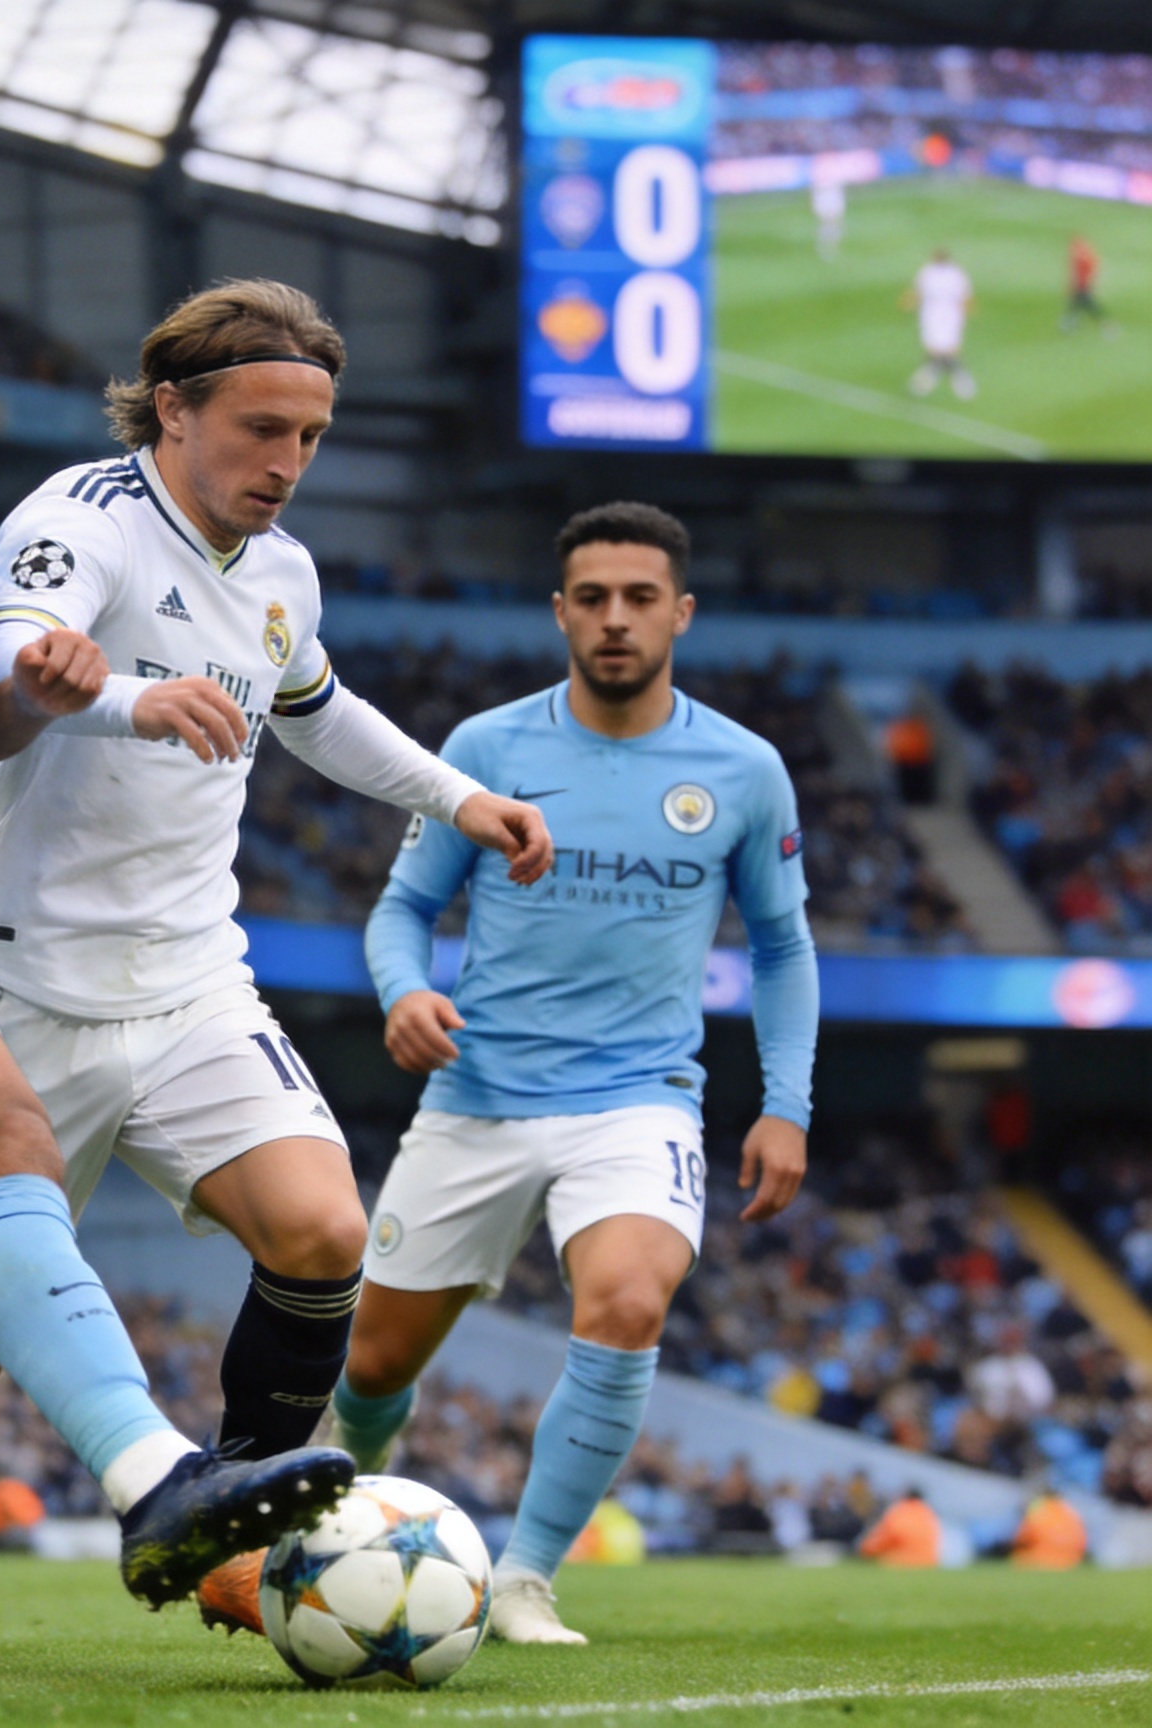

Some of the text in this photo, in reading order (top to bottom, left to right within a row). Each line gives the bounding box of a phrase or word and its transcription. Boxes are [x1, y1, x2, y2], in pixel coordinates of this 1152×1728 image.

[614, 144, 700, 268] 0
[614, 270, 700, 395] 0
[551, 848, 706, 889] TIHAD
